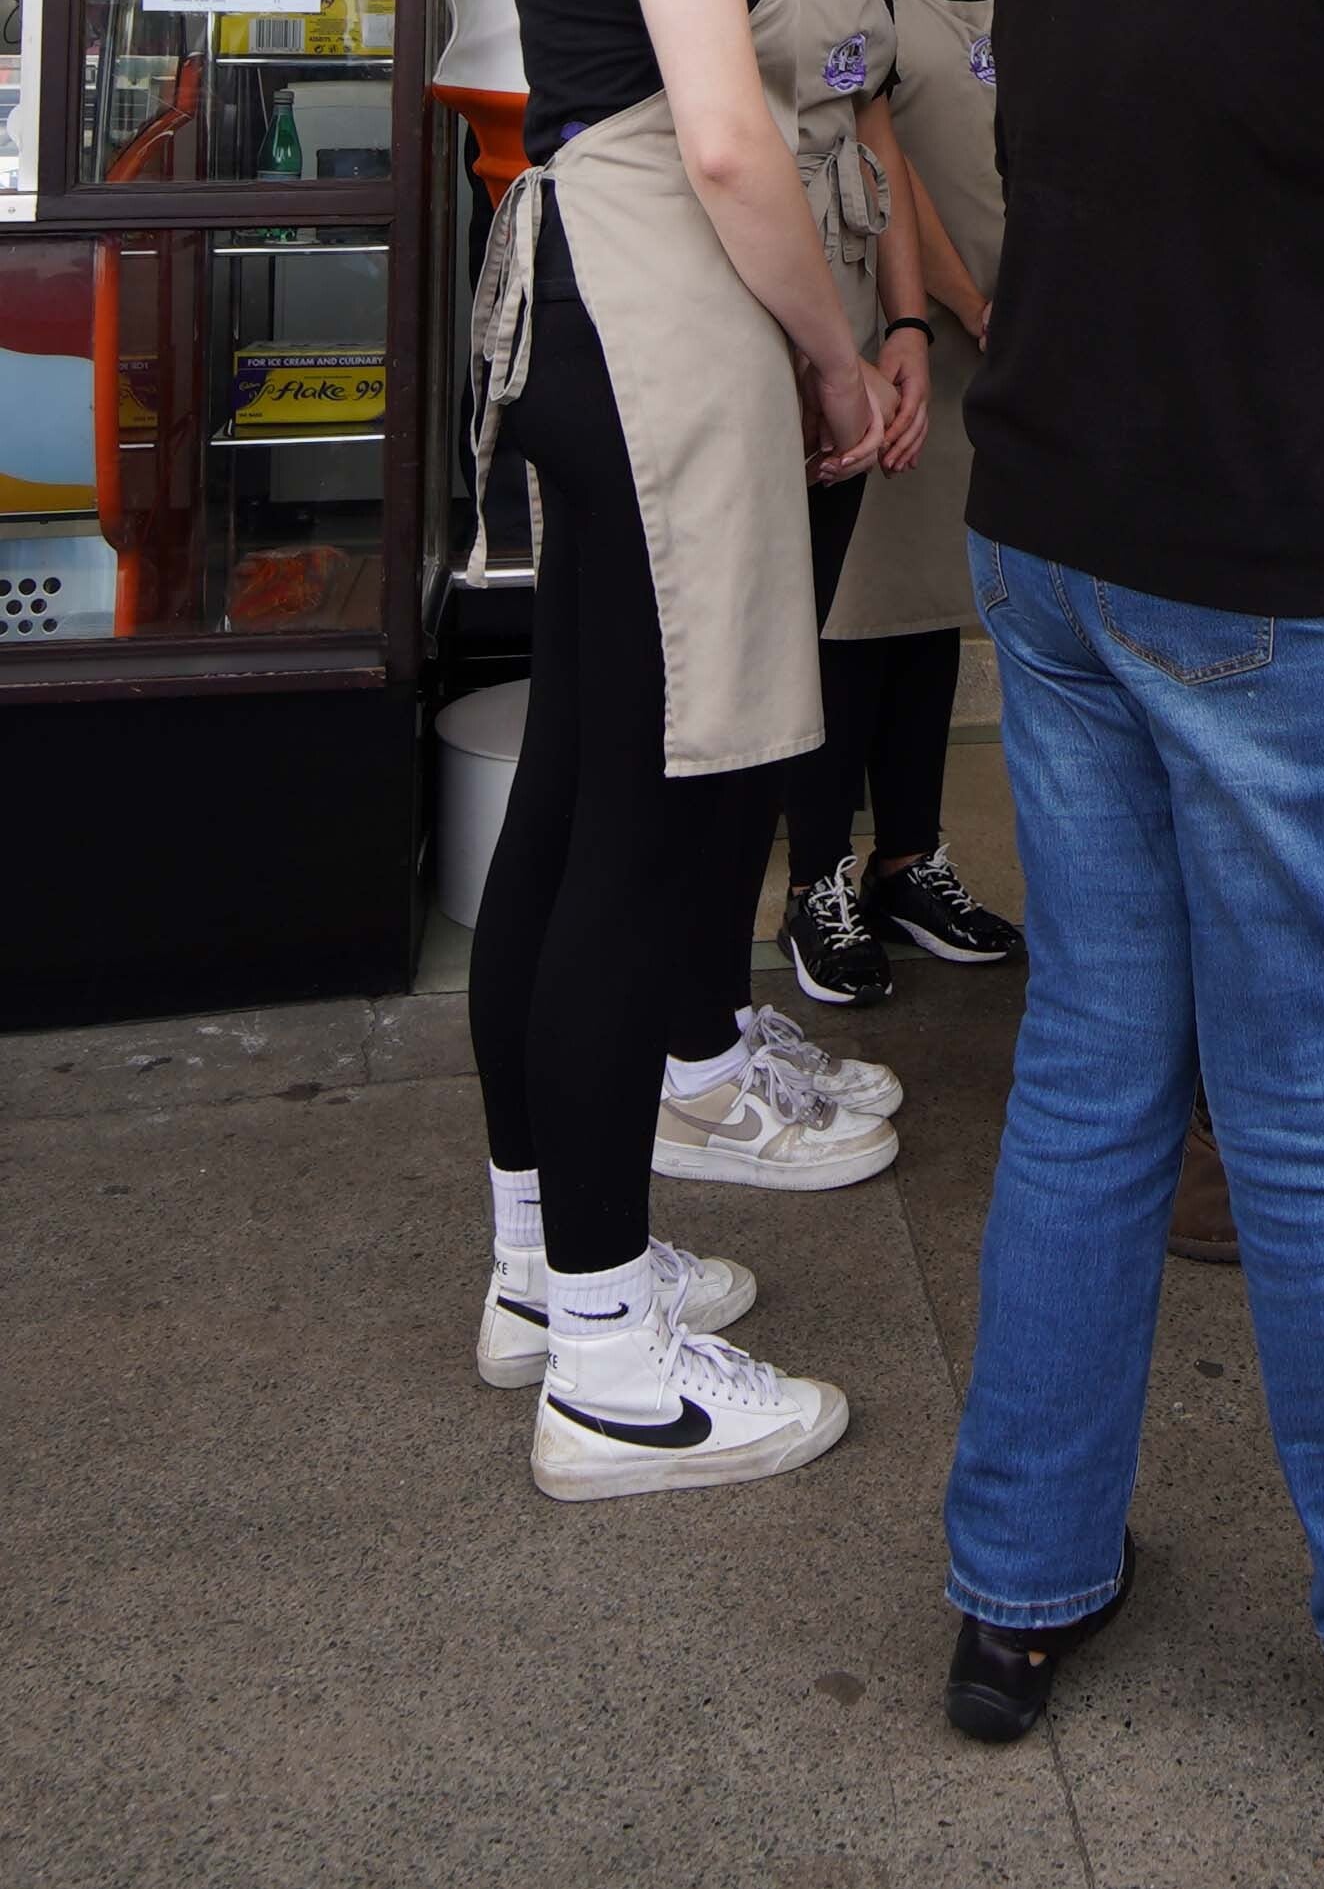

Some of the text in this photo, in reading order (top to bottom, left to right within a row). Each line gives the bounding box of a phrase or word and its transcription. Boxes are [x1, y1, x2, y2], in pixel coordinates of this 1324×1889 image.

[247, 356, 384, 367] FOR ICE CREAM AND CULINARY
[272, 379, 348, 401] flake
[351, 380, 385, 401] 99
[495, 1260, 510, 1276] KE
[547, 1352, 559, 1370] KE
